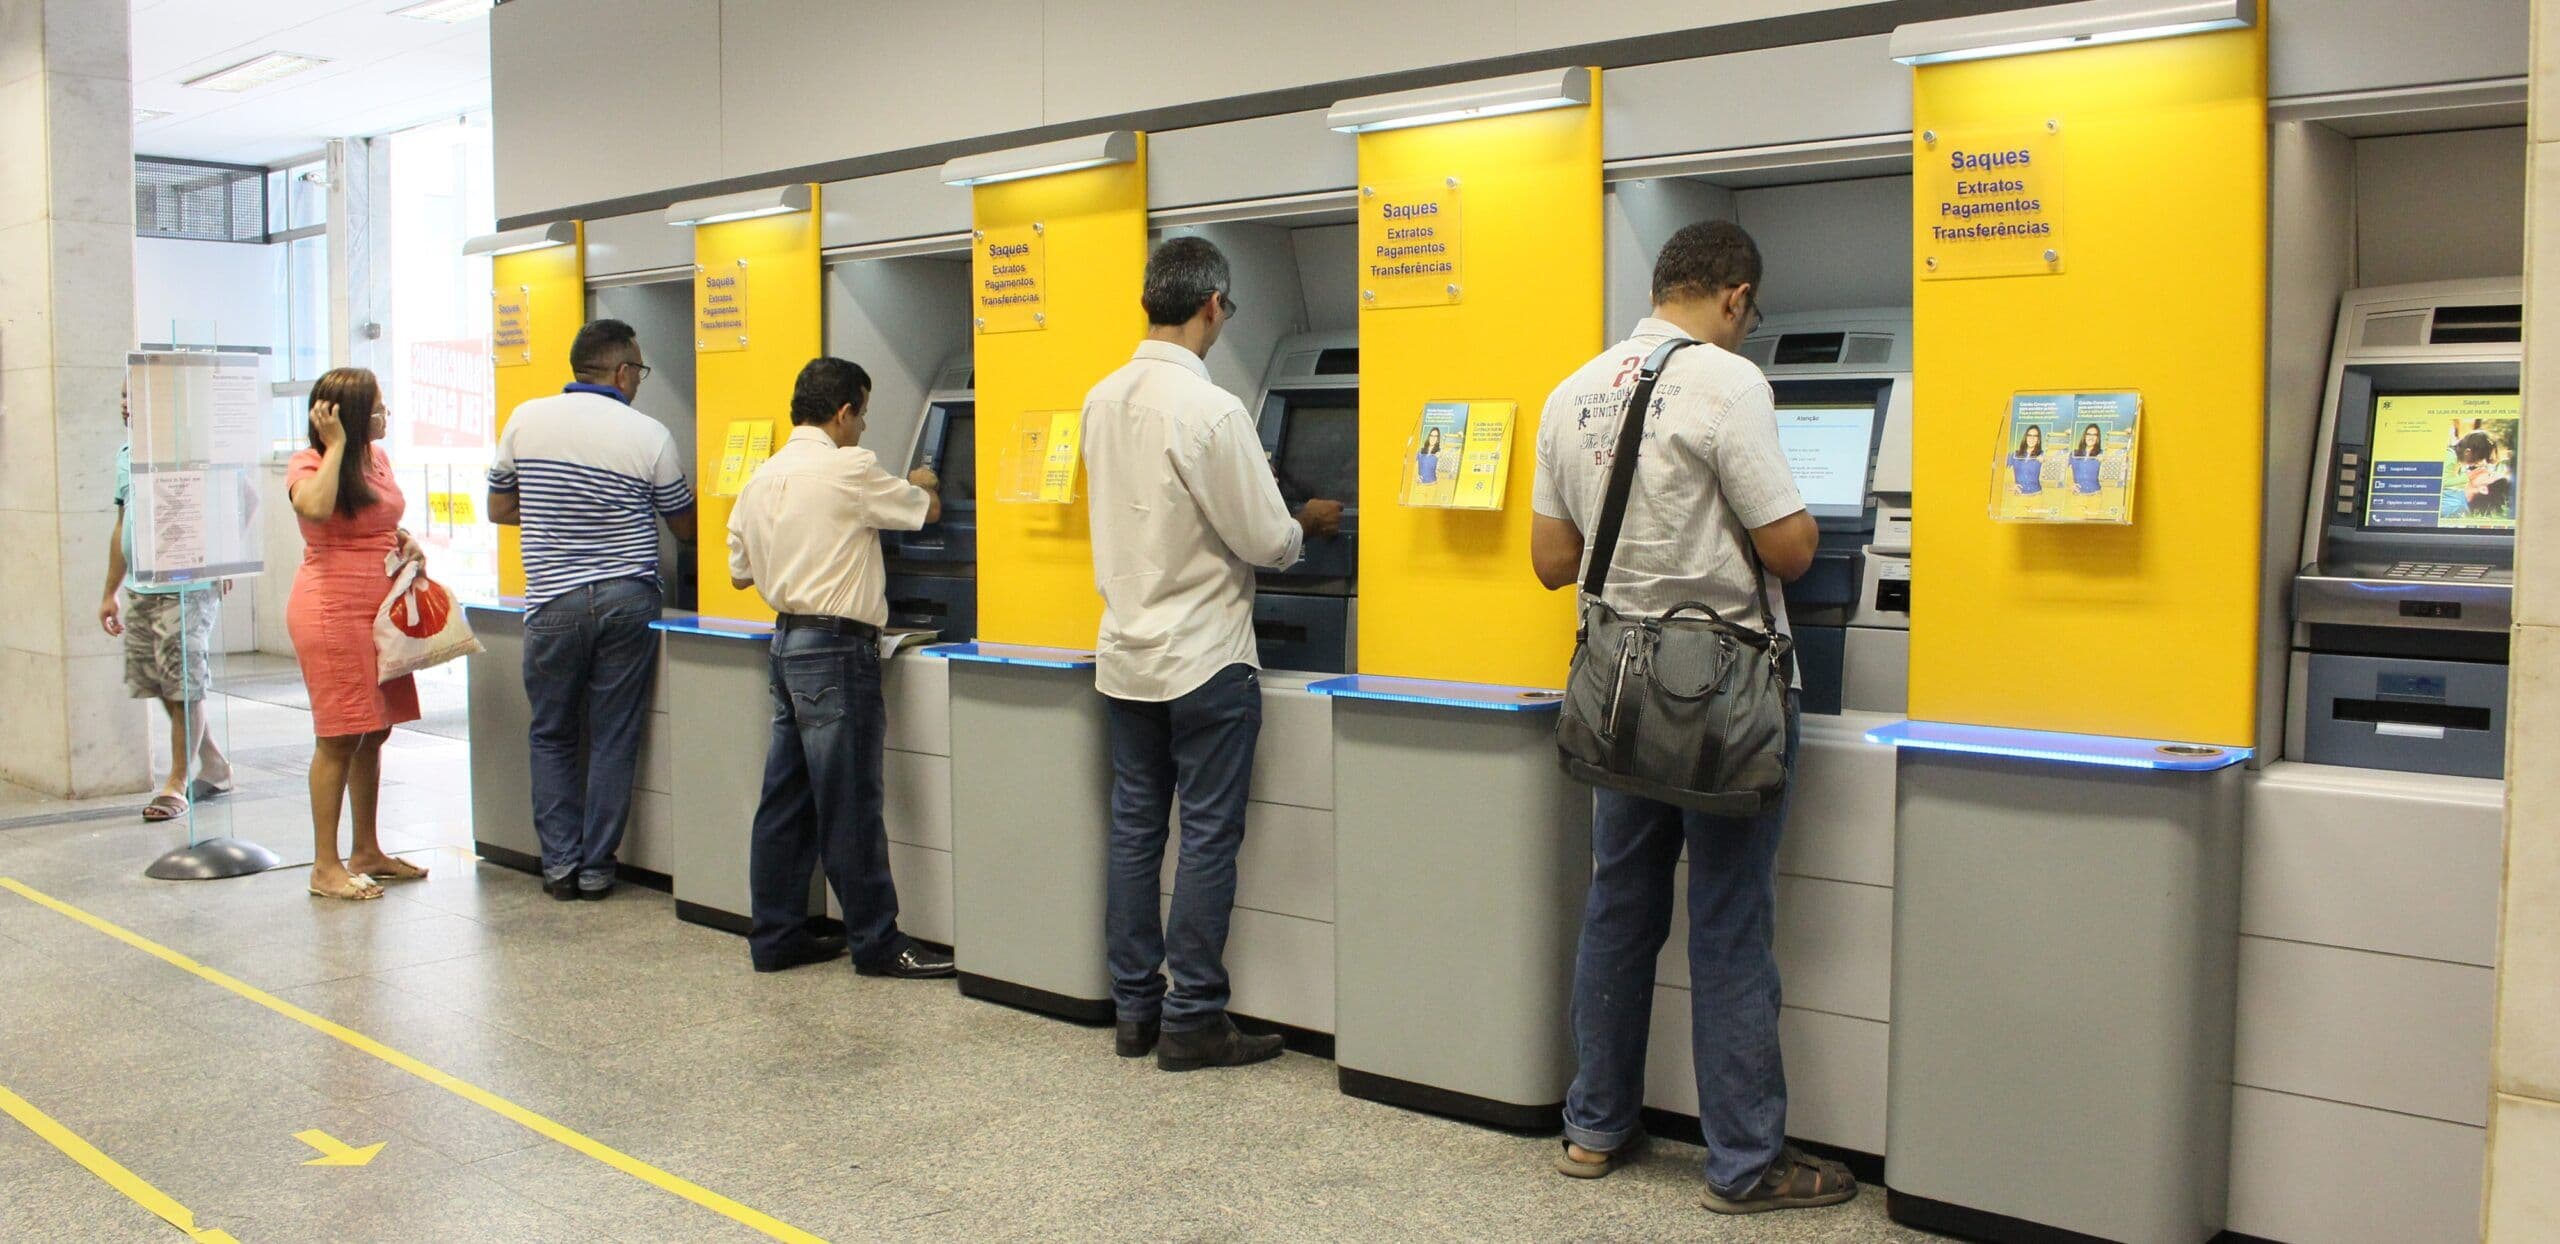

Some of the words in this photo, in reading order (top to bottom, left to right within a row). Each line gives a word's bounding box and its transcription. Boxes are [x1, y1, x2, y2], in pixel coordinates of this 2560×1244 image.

[1951, 150, 2030, 170] Saques
[1957, 180, 2024, 195] Extratos
[1383, 202, 1438, 220] Saques
[1941, 199, 2040, 218] Pagamentos
[1387, 227, 1434, 240] Extratos
[1932, 221, 2050, 239] Transferências
[989, 243, 1029, 258] Saques
[1376, 243, 1445, 259] Pagamentos
[992, 264, 1026, 275] Extratos
[1370, 261, 1452, 276] Transferências
[706, 277, 735, 288] Saques
[985, 277, 1034, 291] Pagamentos
[981, 293, 1040, 306] Transferências
[1612, 356, 1649, 388] 2
[1656, 384, 1681, 396] CLUB
